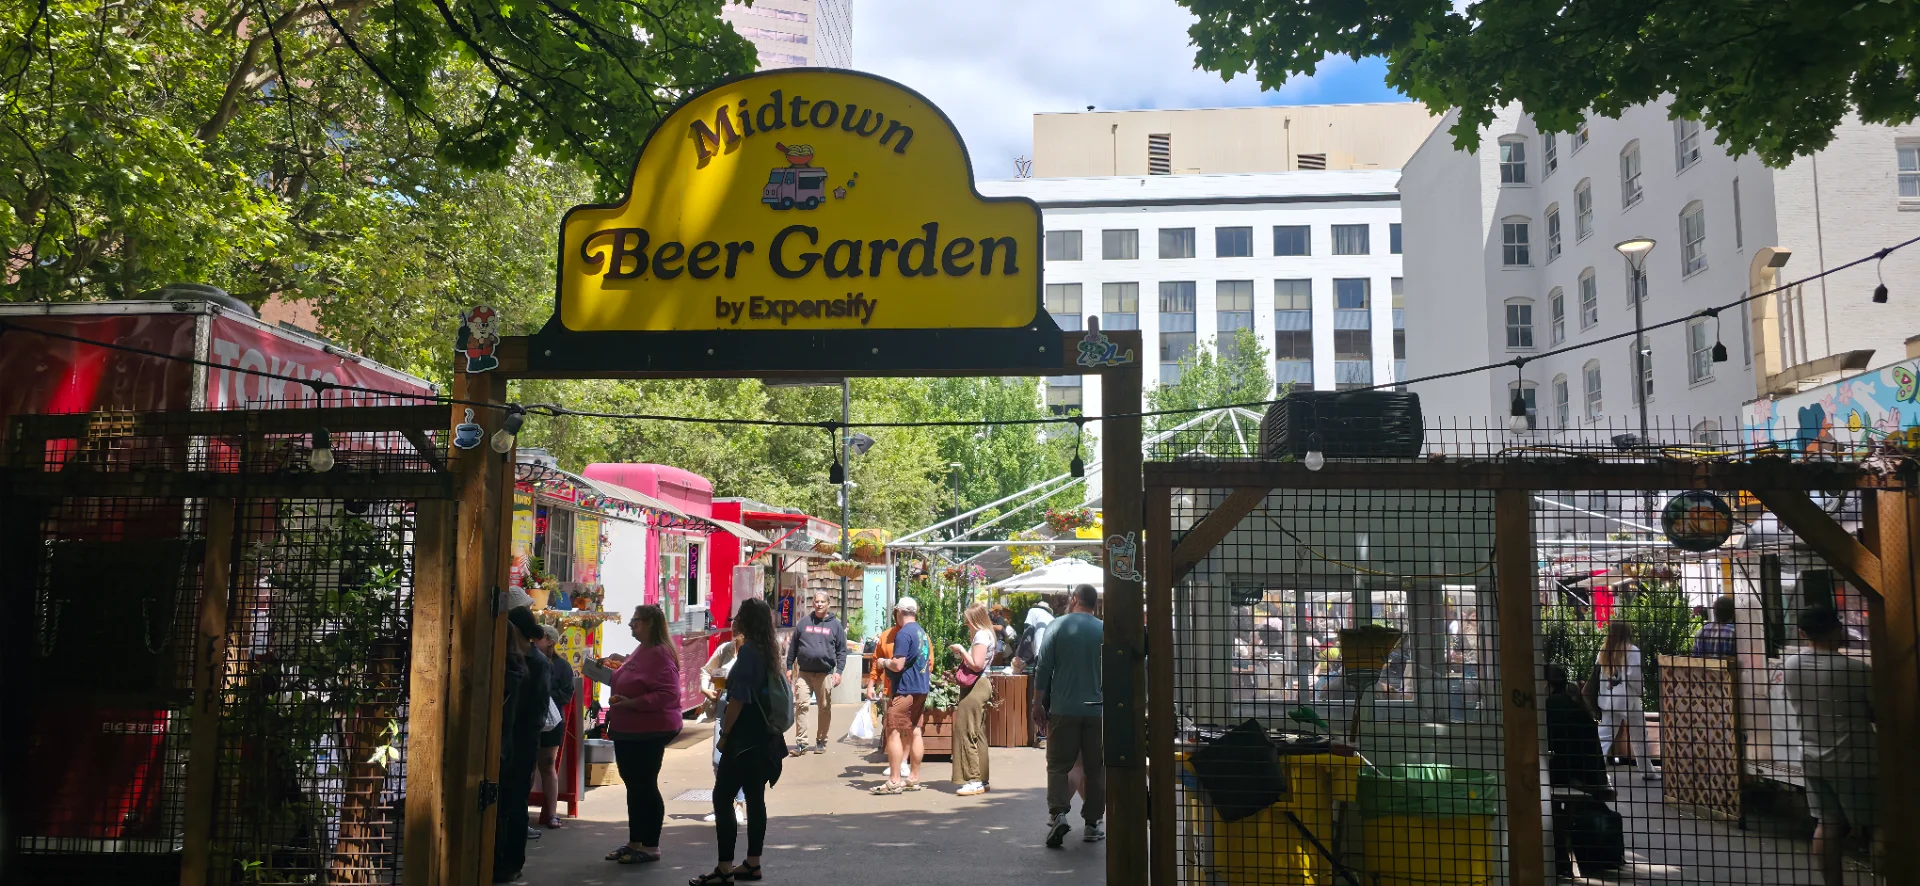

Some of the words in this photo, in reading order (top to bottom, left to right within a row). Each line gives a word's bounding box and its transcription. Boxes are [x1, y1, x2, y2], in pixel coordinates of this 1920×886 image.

[690, 89, 914, 160] Midtown
[580, 227, 755, 280] Beer
[768, 221, 1020, 279] Garden
[715, 296, 745, 325] by
[749, 292, 878, 326] Expensify
[212, 338, 343, 411] TOKYO
